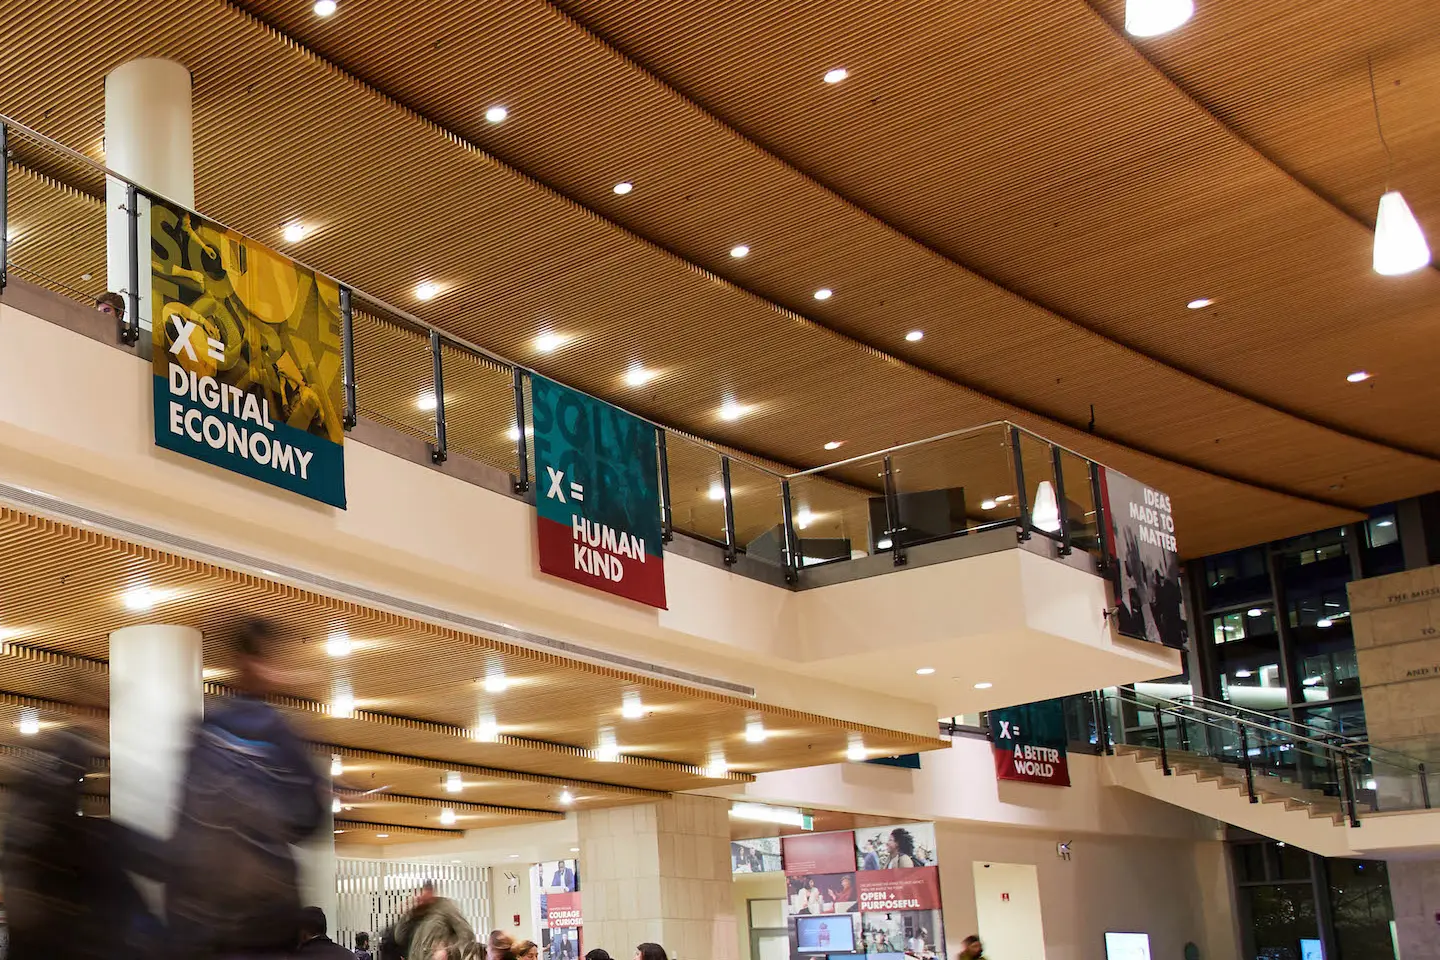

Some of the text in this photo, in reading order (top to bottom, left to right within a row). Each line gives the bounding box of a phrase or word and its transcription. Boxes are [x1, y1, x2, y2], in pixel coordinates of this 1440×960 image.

[168, 314, 199, 363] X
[168, 361, 275, 432] DIGITAL
[169, 399, 314, 480] ECONOMY
[546, 465, 567, 504] X
[1143, 488, 1172, 513] IDEAS
[1129, 501, 1174, 533] MADE TO
[572, 513, 646, 563] HUMAN
[1139, 524, 1178, 553] MATTER
[573, 542, 624, 583] KIND
[1406, 668, 1429, 677] AND
[999, 720, 1012, 739] X
[1014, 743, 1060, 764] A BETTER
[1014, 759, 1054, 778] WORLD
[860, 891, 887, 901] OPEN
[861, 899, 920, 910] PURPOSEFUL
[549, 910, 580, 919] COURAGE
